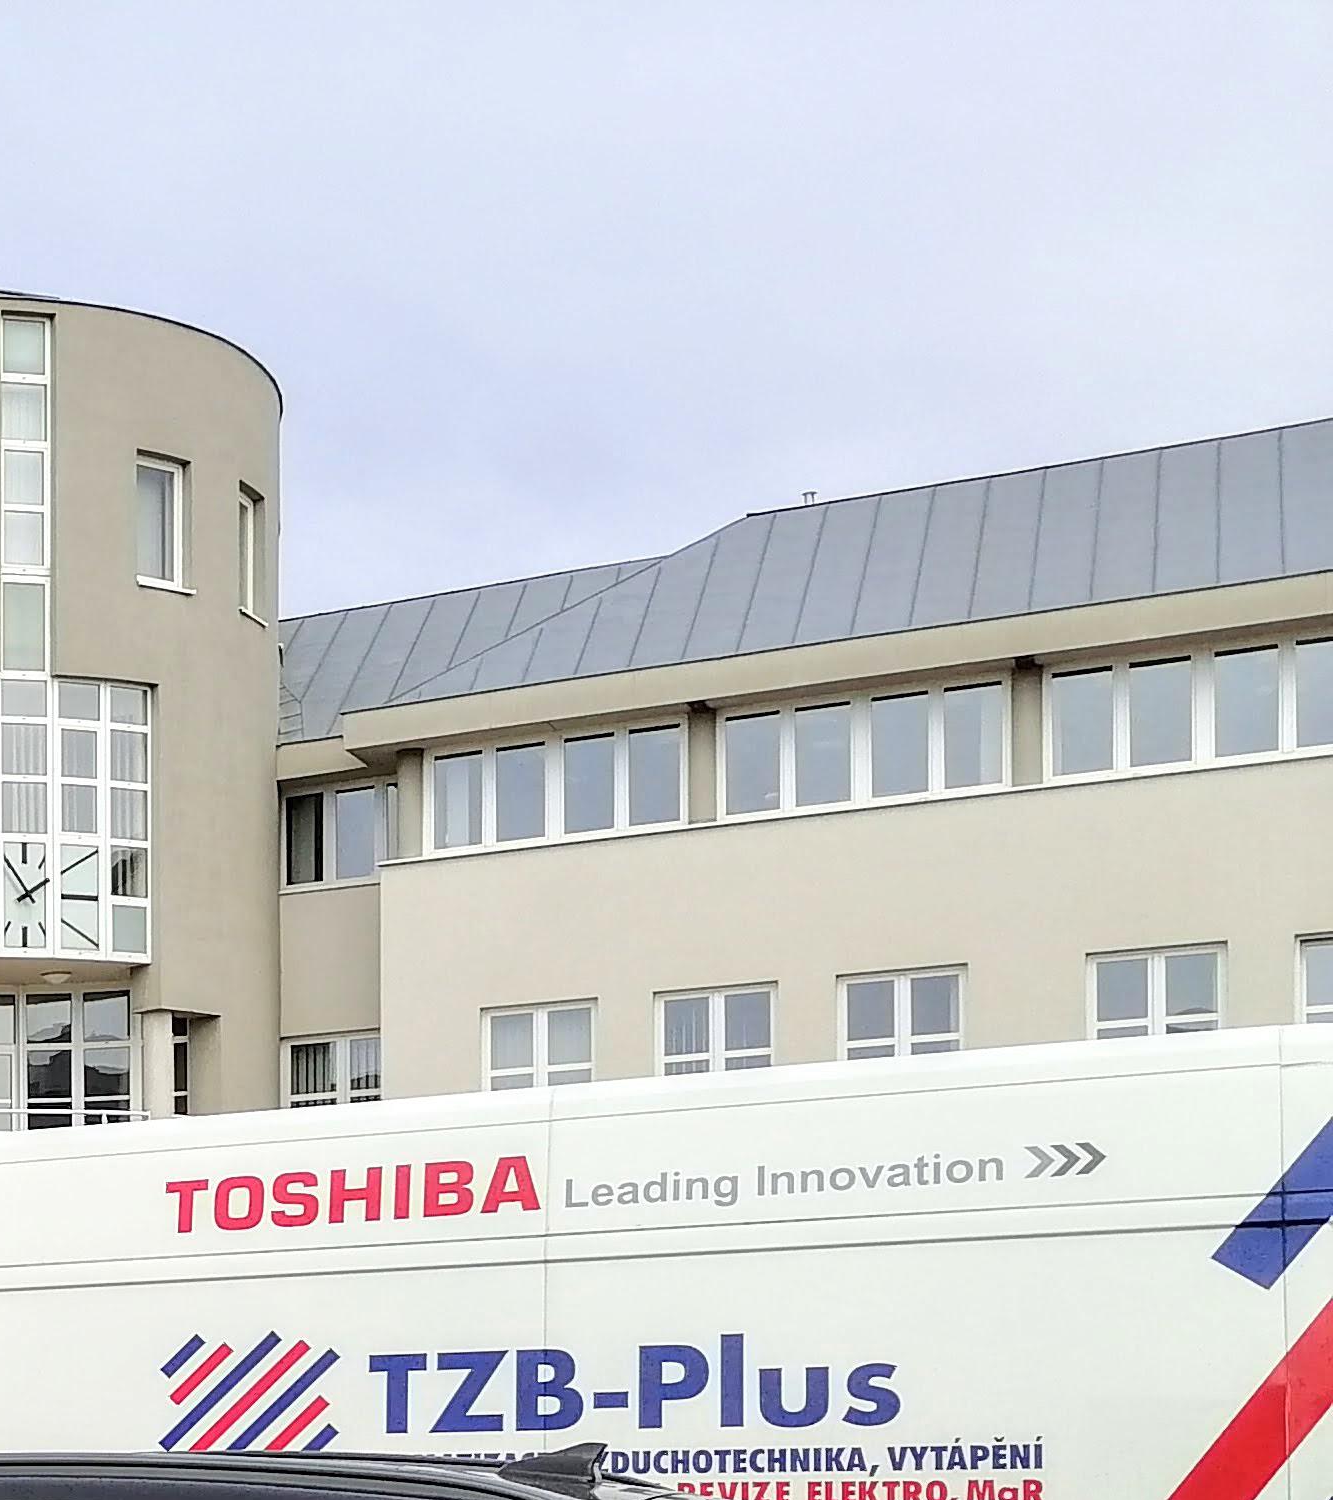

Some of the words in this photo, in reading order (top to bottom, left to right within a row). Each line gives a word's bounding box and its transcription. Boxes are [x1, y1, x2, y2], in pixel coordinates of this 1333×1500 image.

[165, 1155, 541, 1234] TOSHIBA
[564, 1168, 740, 1208] Leading
[756, 1152, 1005, 1196] Innovation
[369, 1333, 902, 1434] TZB-Plus
[887, 1435, 1044, 1471] VYTÁPĚNÍ
